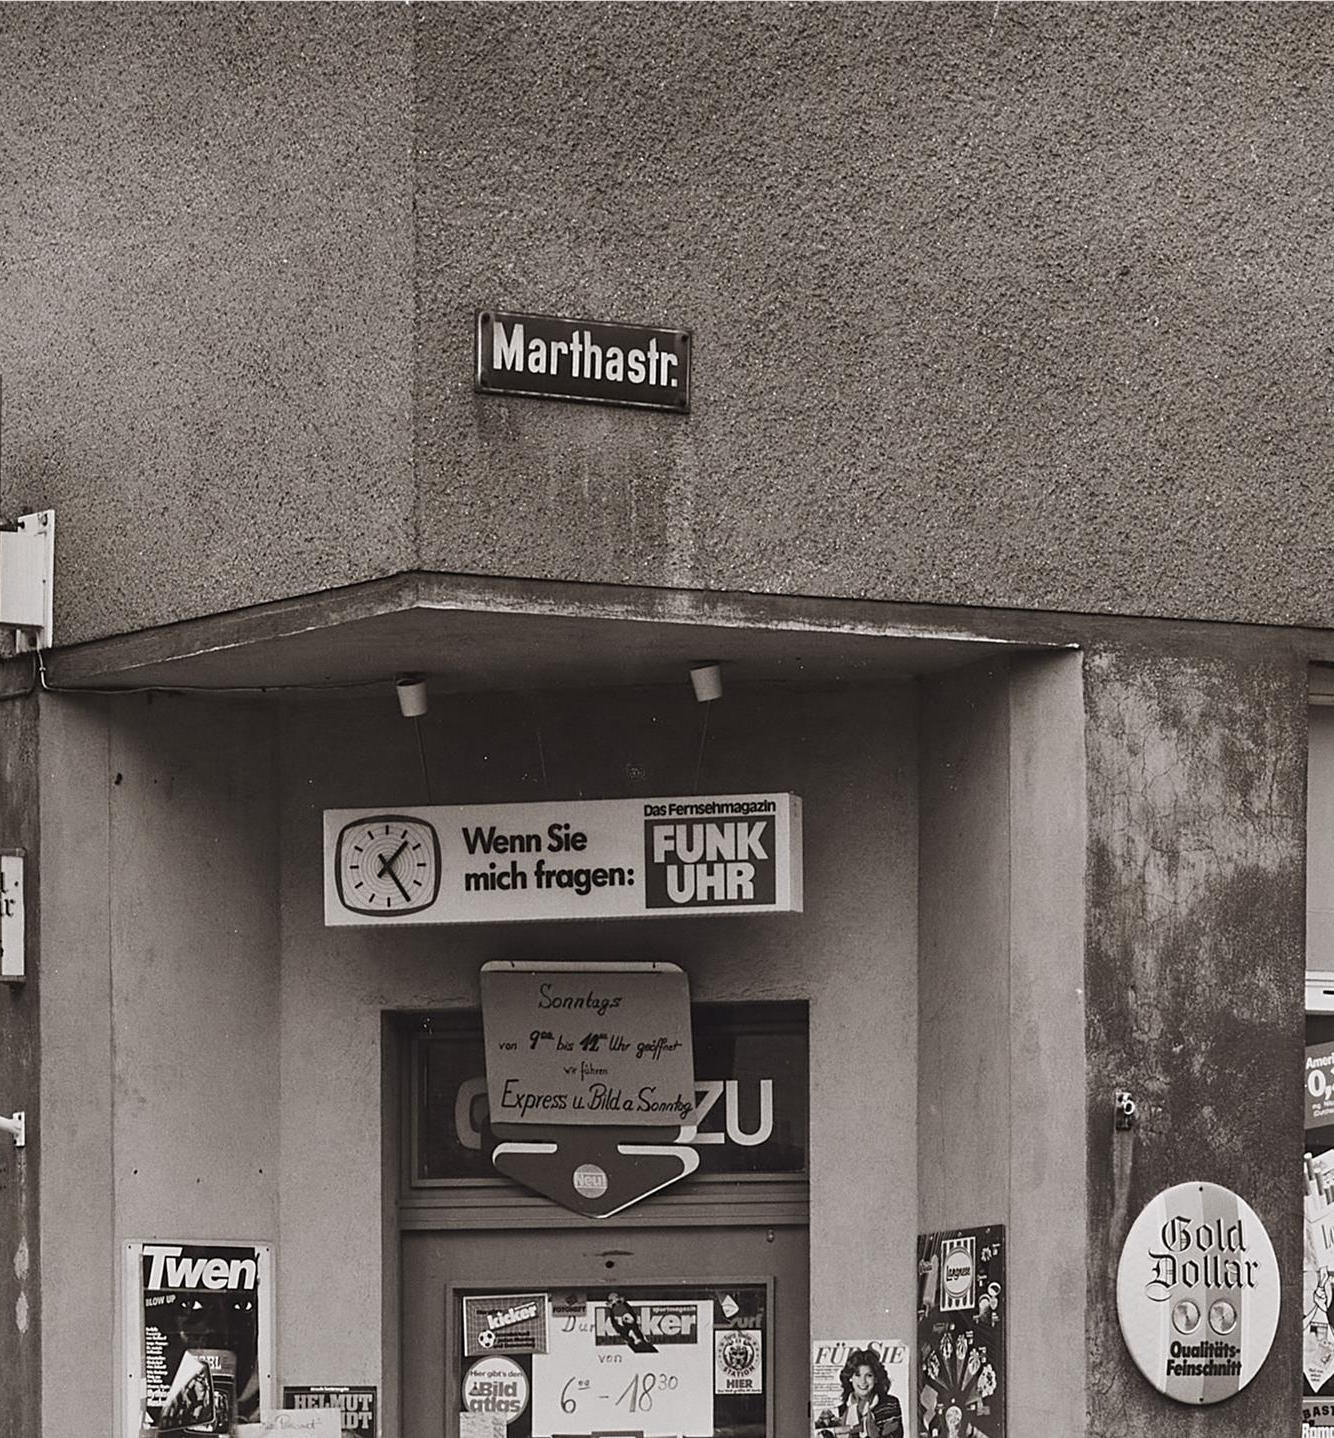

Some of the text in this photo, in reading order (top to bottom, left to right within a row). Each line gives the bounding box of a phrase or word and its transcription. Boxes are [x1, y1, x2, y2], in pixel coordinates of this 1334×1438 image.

[493, 322, 678, 387] Marthastr.
[644, 800, 776, 817] Das Fernsehmagazin
[462, 824, 587, 857] Wenn Sie
[653, 821, 768, 863] FUNK
[465, 860, 634, 896] mich fragen:
[666, 863, 756, 904] UHR
[539, 984, 622, 1016] Sonntags
[499, 1041, 517, 1051] von
[557, 1038, 574, 1052] bis
[609, 1034, 631, 1051] Uhr
[580, 1060, 608, 1081] führen
[501, 1080, 693, 1119] Express Bild Sonntag
[1161, 1216, 1247, 1252] Gold
[142, 1245, 256, 1291] Twen
[1145, 1248, 1259, 1302] Dollar
[166, 1294, 177, 1303] UP
[598, 1354, 623, 1364] von
[1170, 1340, 1241, 1359] Qualitäts-
[723, 1365, 755, 1377] STATION
[1166, 1359, 1242, 1376] Feinschnitt
[479, 1381, 518, 1397] Bild
[726, 1379, 753, 1389] HIER
[294, 1394, 373, 1410] HELMUT
